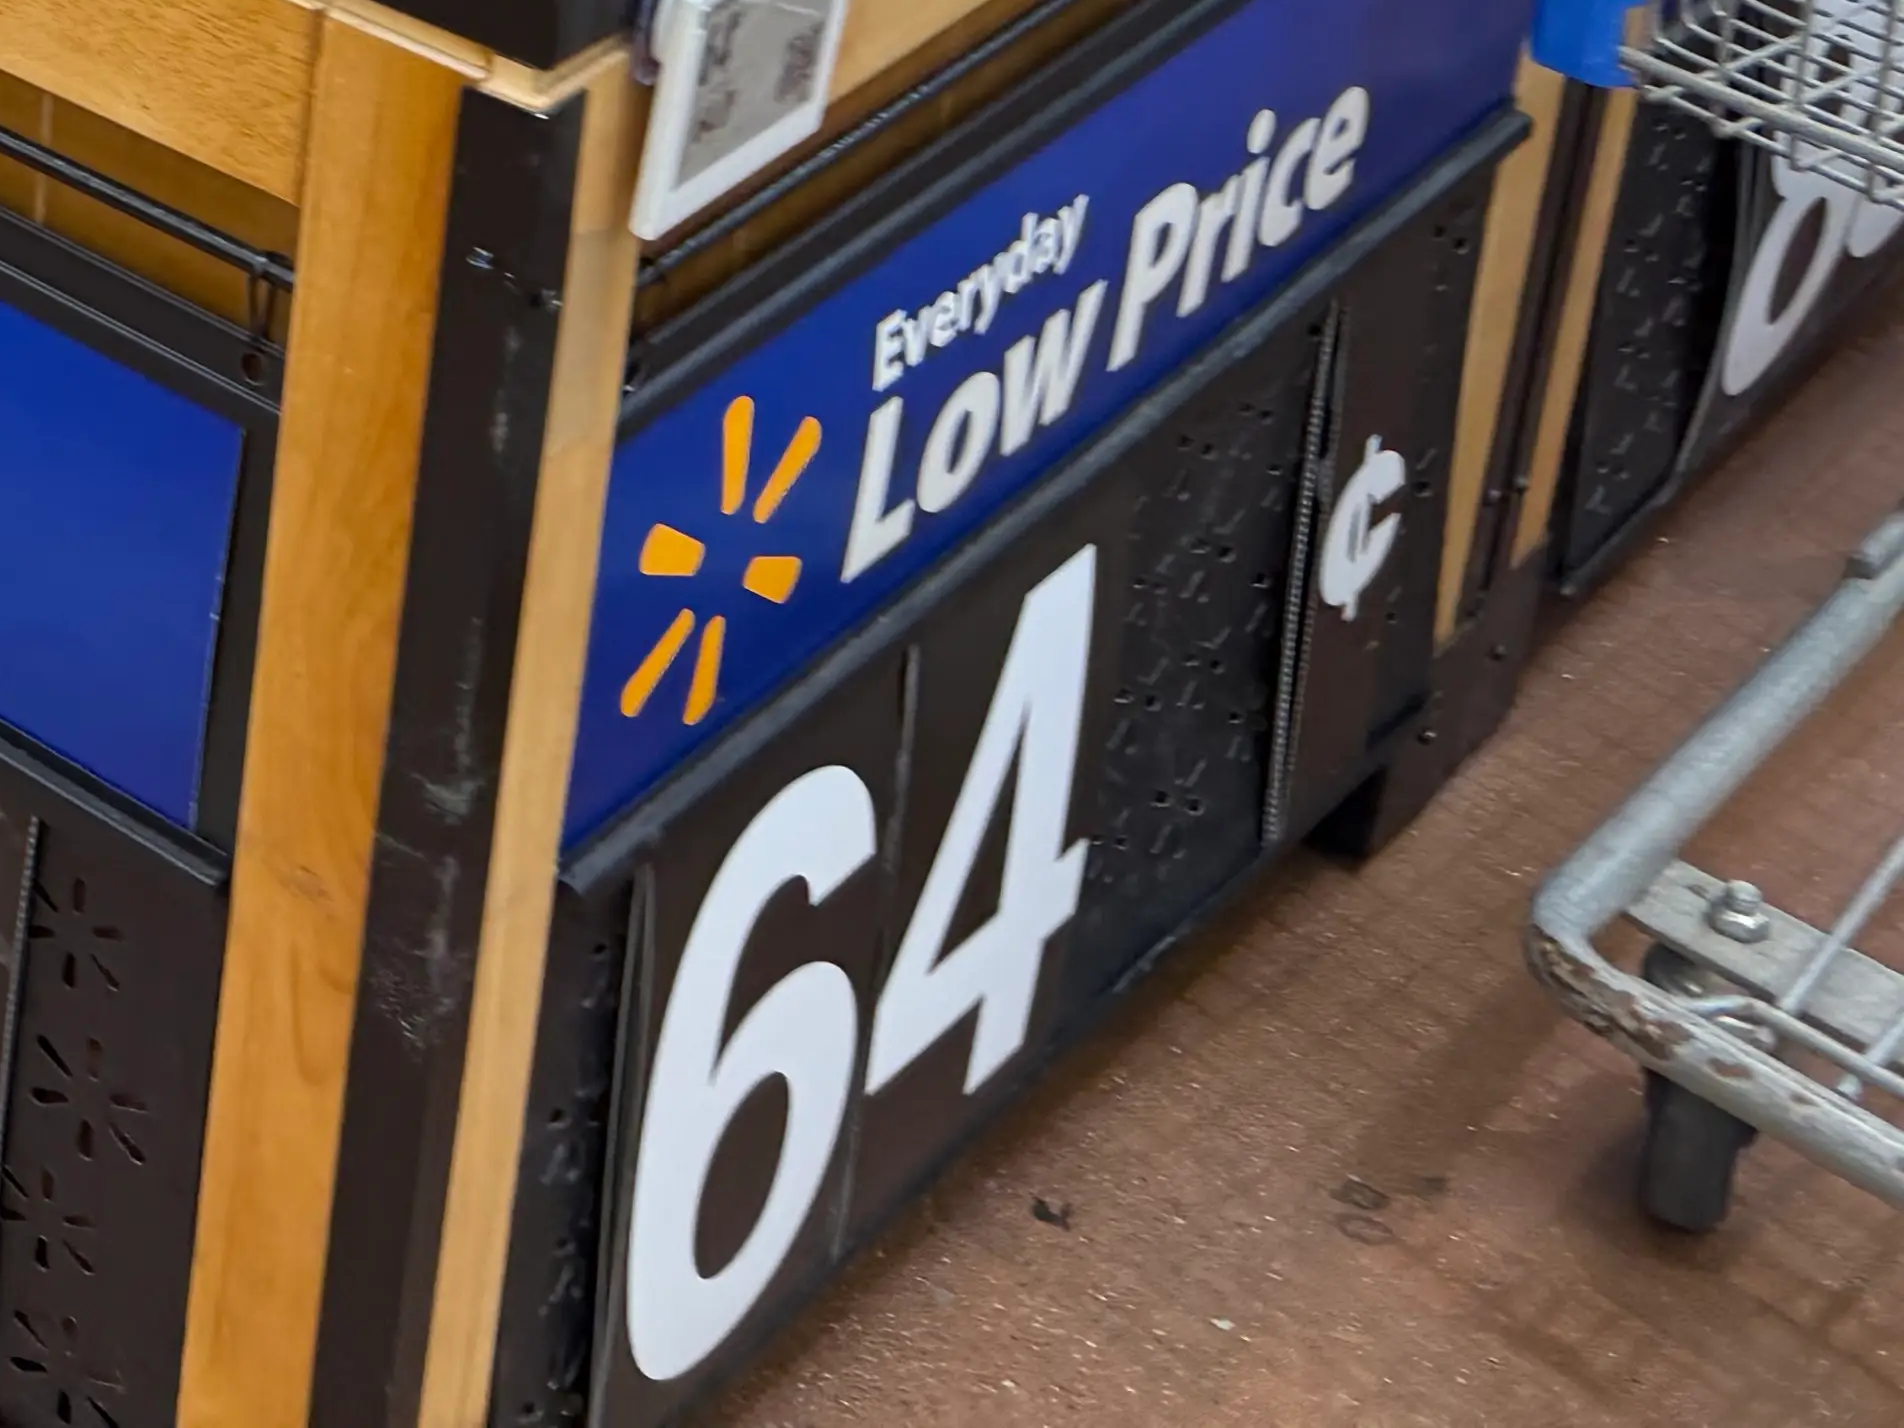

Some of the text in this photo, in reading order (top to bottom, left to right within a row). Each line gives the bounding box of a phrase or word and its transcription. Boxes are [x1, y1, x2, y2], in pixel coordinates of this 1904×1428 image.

[840, 86, 1368, 583] Low Price
[872, 191, 1089, 392] Everyday
[626, 543, 1097, 1382] 64
